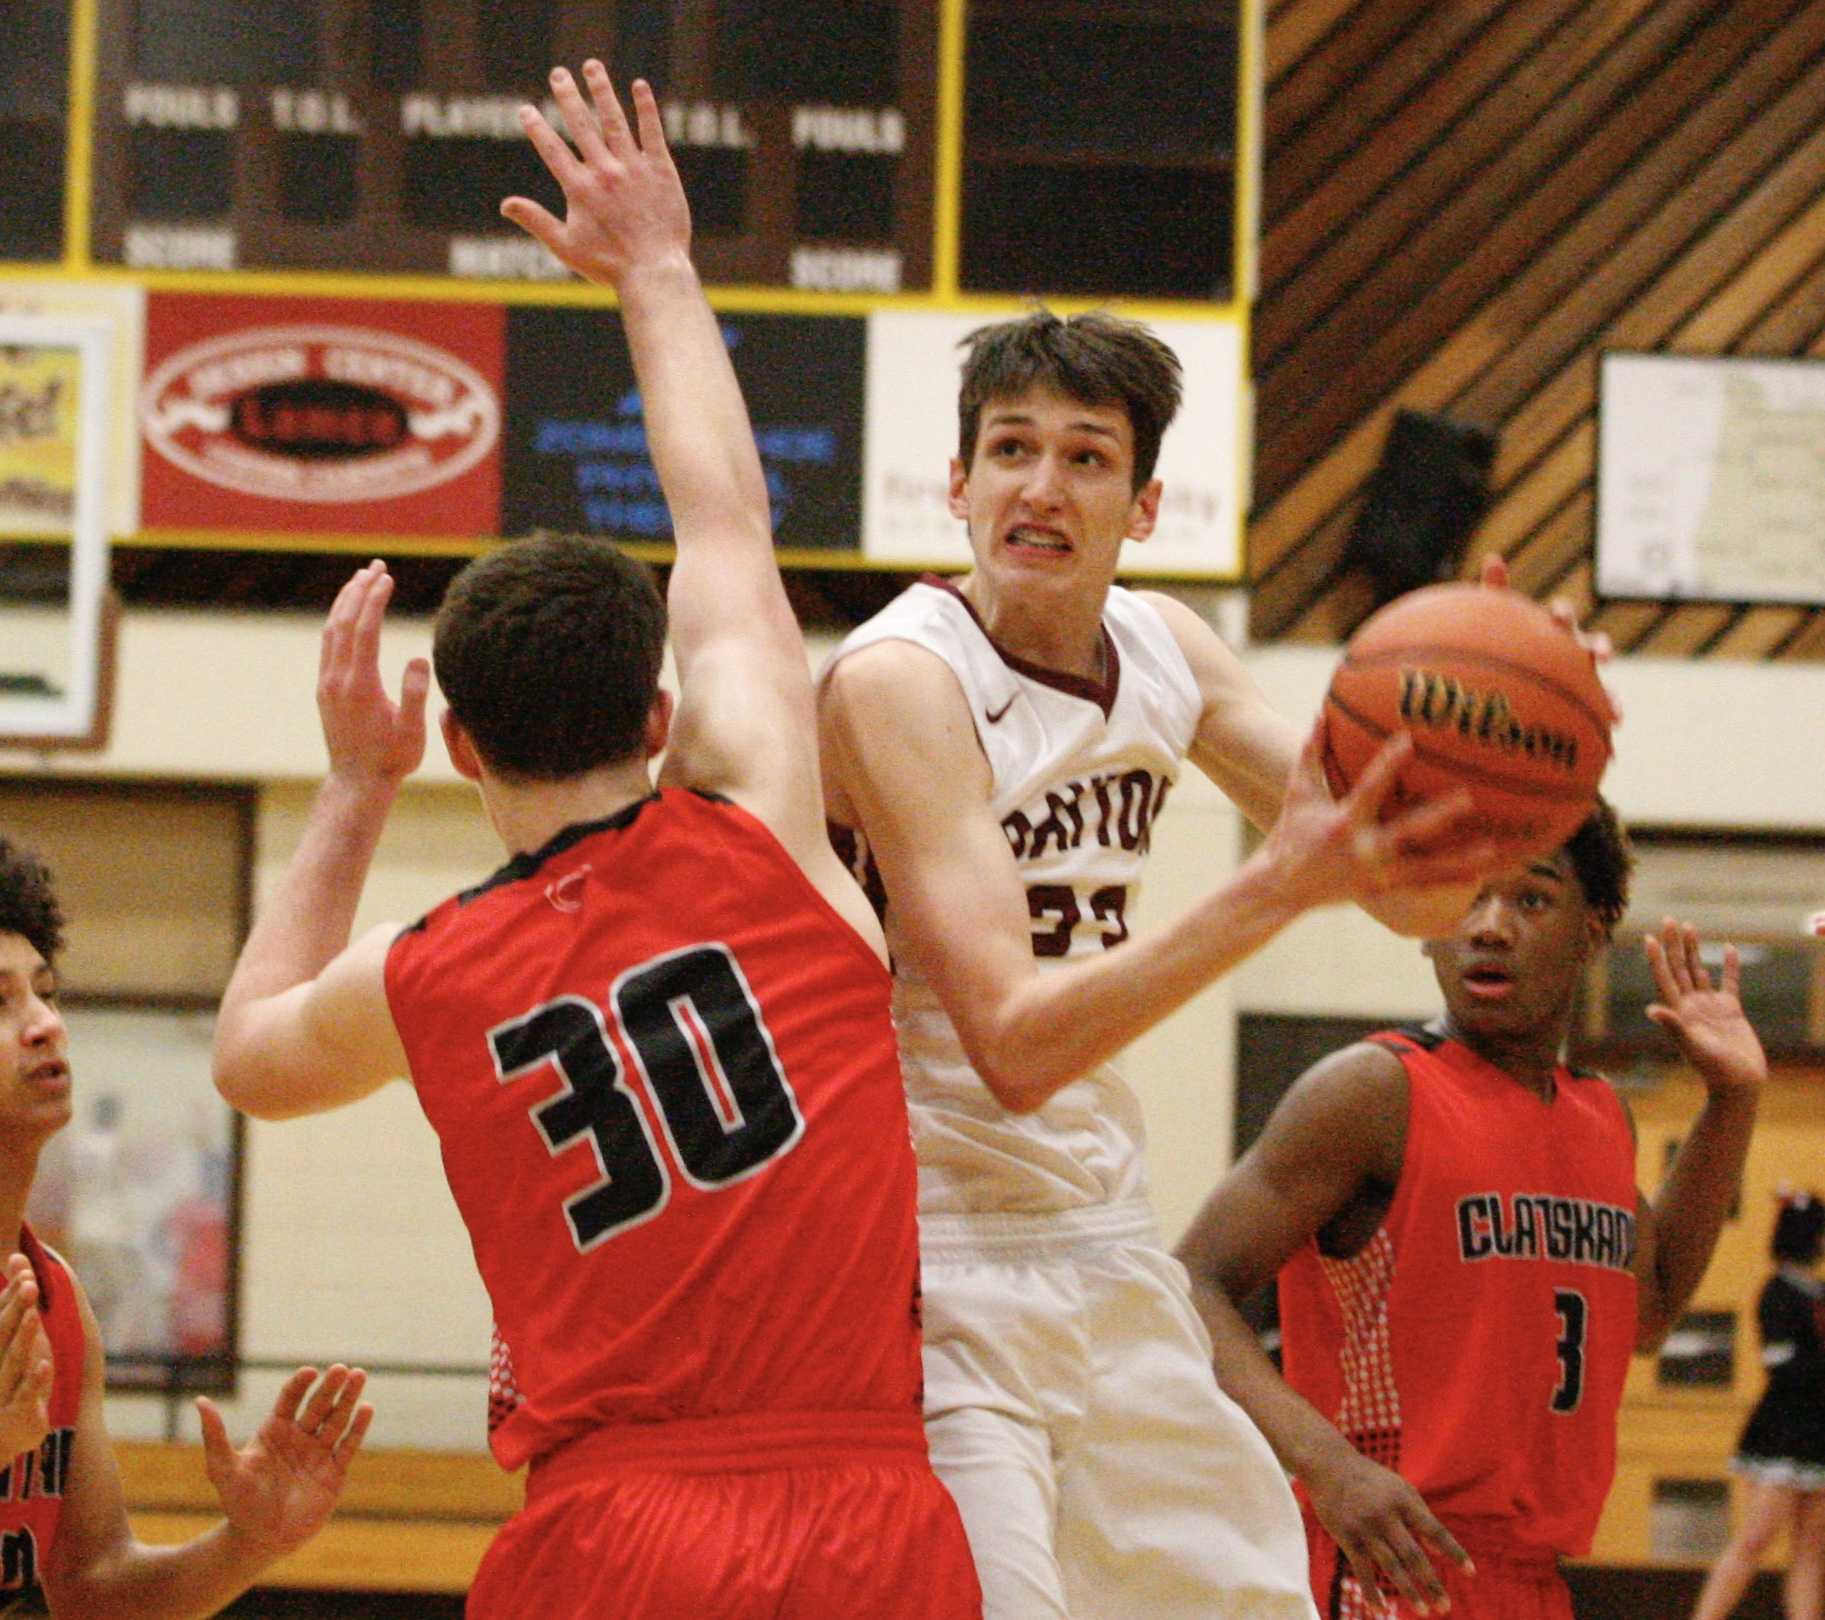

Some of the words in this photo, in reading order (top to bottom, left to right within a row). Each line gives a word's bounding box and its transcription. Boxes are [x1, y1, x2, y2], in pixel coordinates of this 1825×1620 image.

[1399, 664, 1578, 772] Wilson
[486, 941, 807, 1254] 30
[1548, 1285, 1589, 1416] 3
